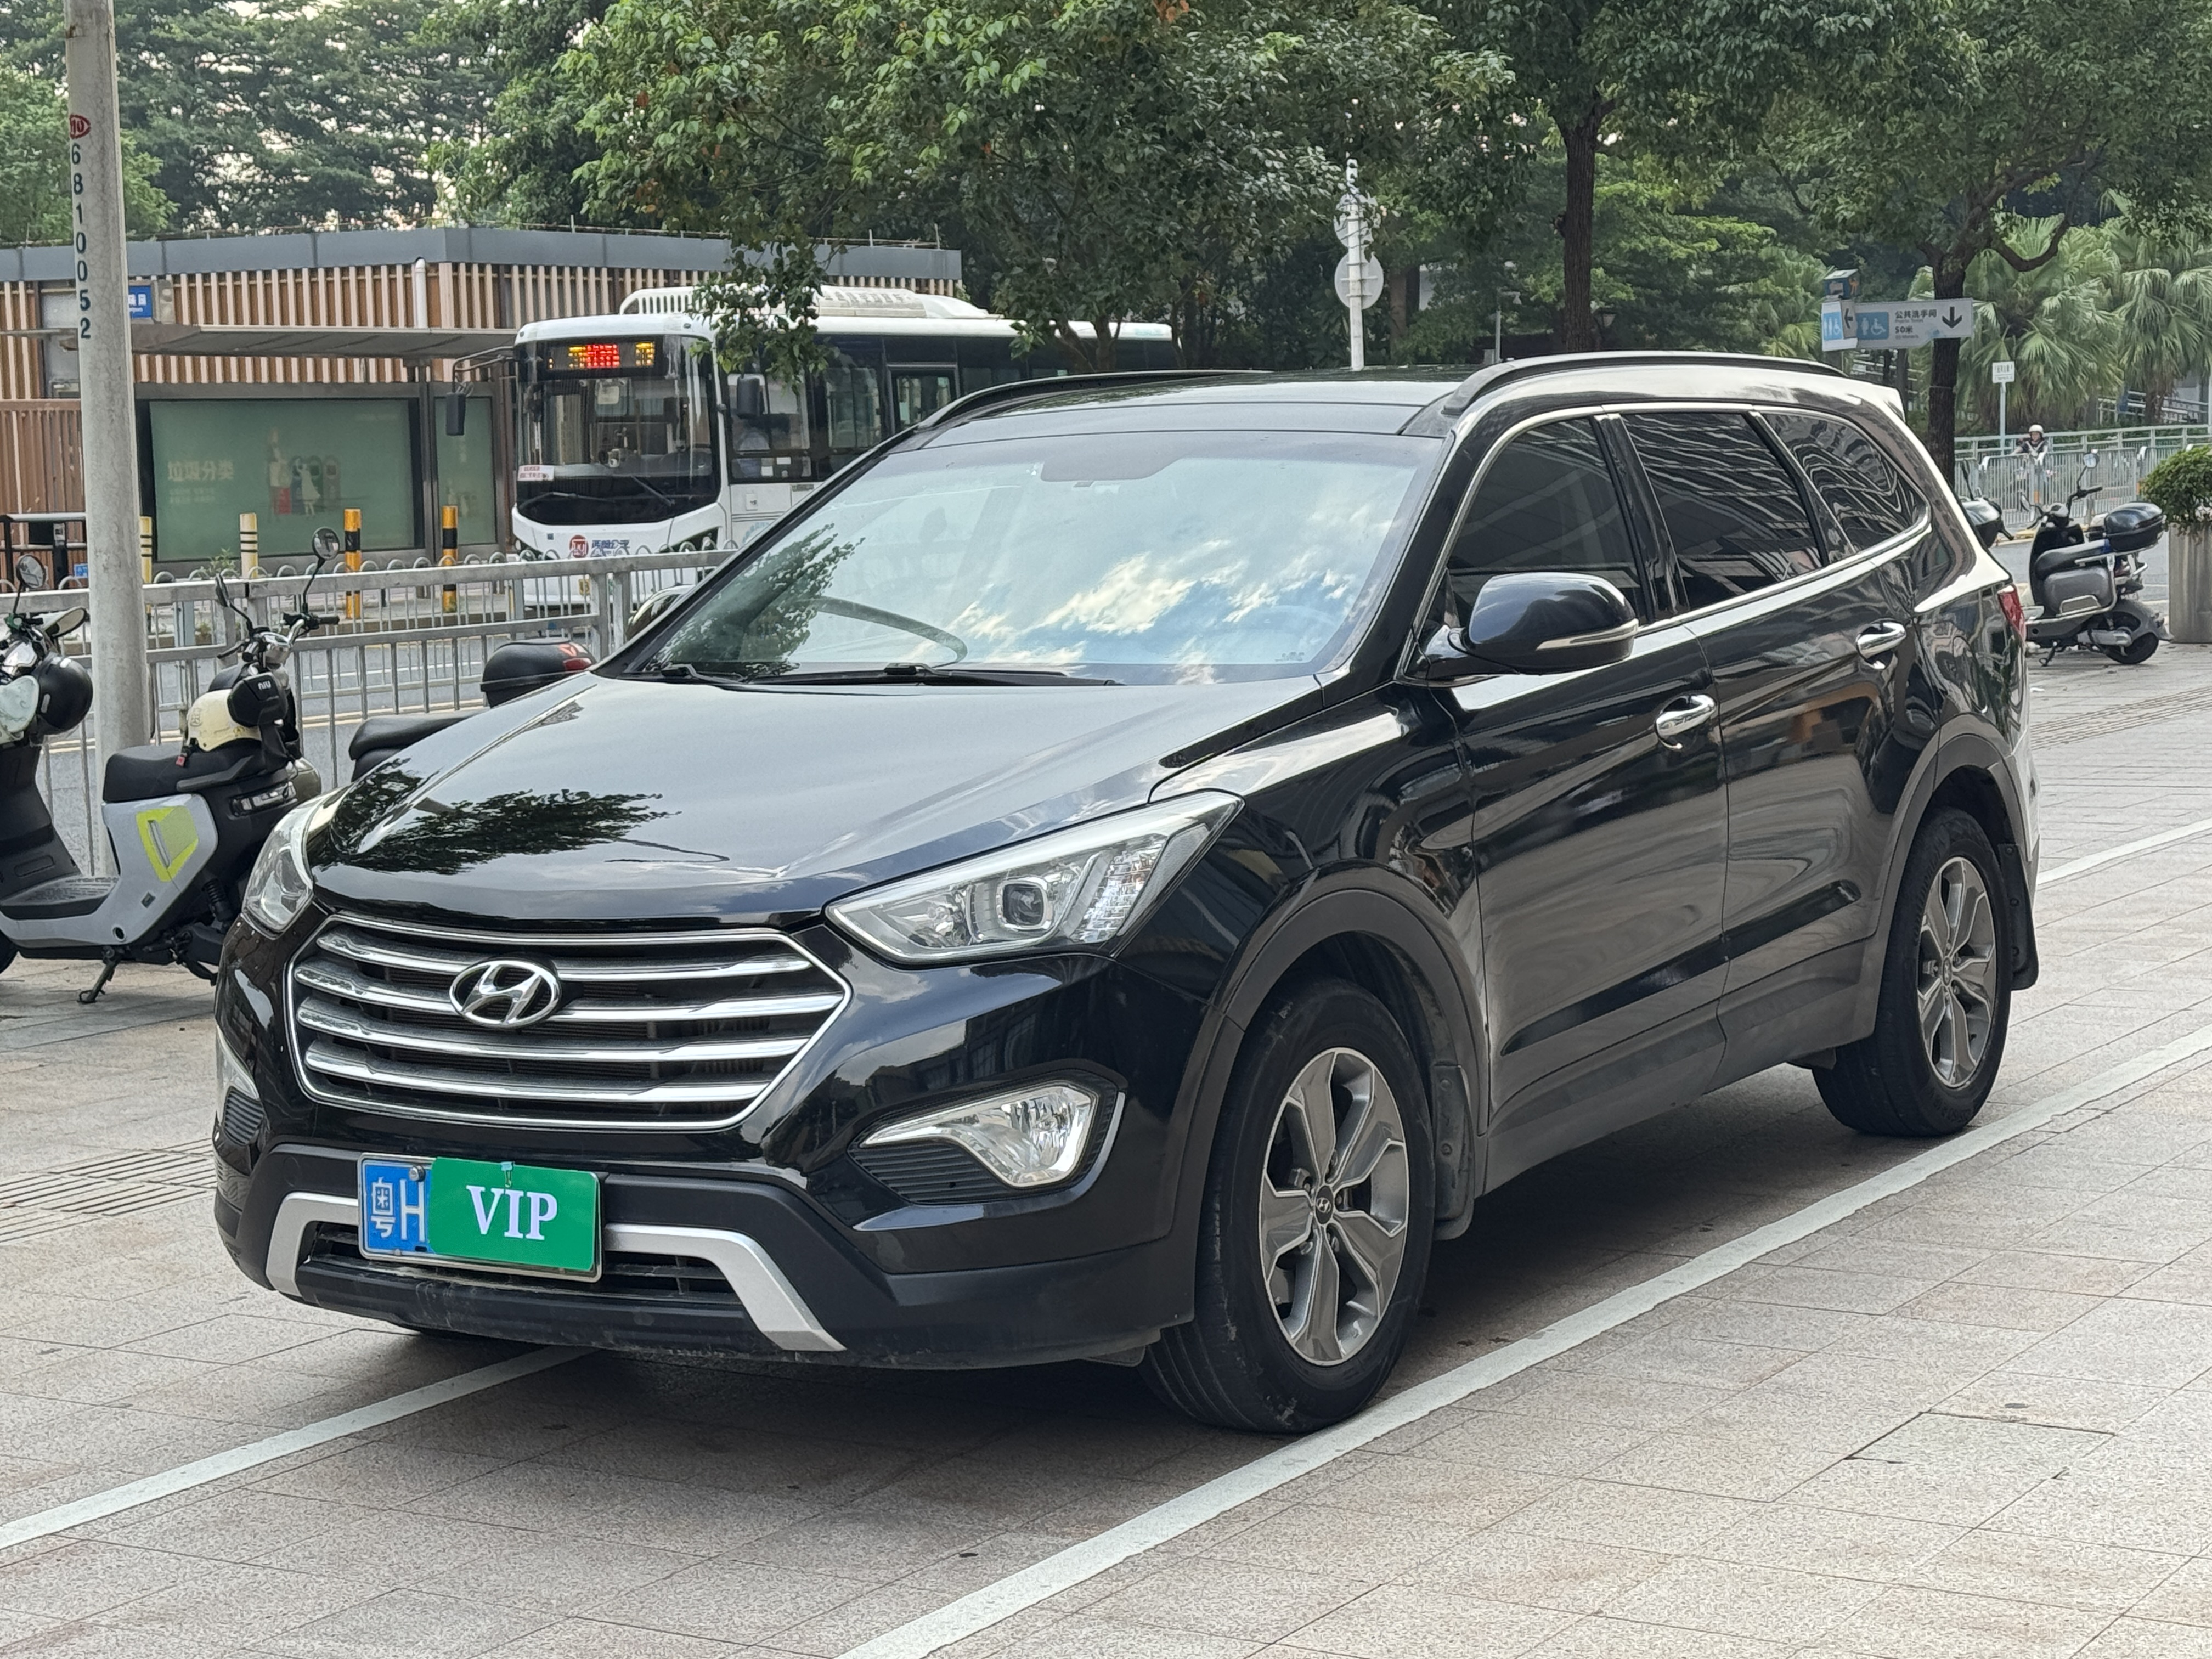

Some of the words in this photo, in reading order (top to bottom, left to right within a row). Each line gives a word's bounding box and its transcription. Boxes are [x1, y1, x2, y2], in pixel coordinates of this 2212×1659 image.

[72, 143, 91, 339] 6810052
[1895, 309, 1937, 319] 公共洗手间
[1895, 325, 1913, 334] 50米
[466, 1185, 557, 1240] VIP
